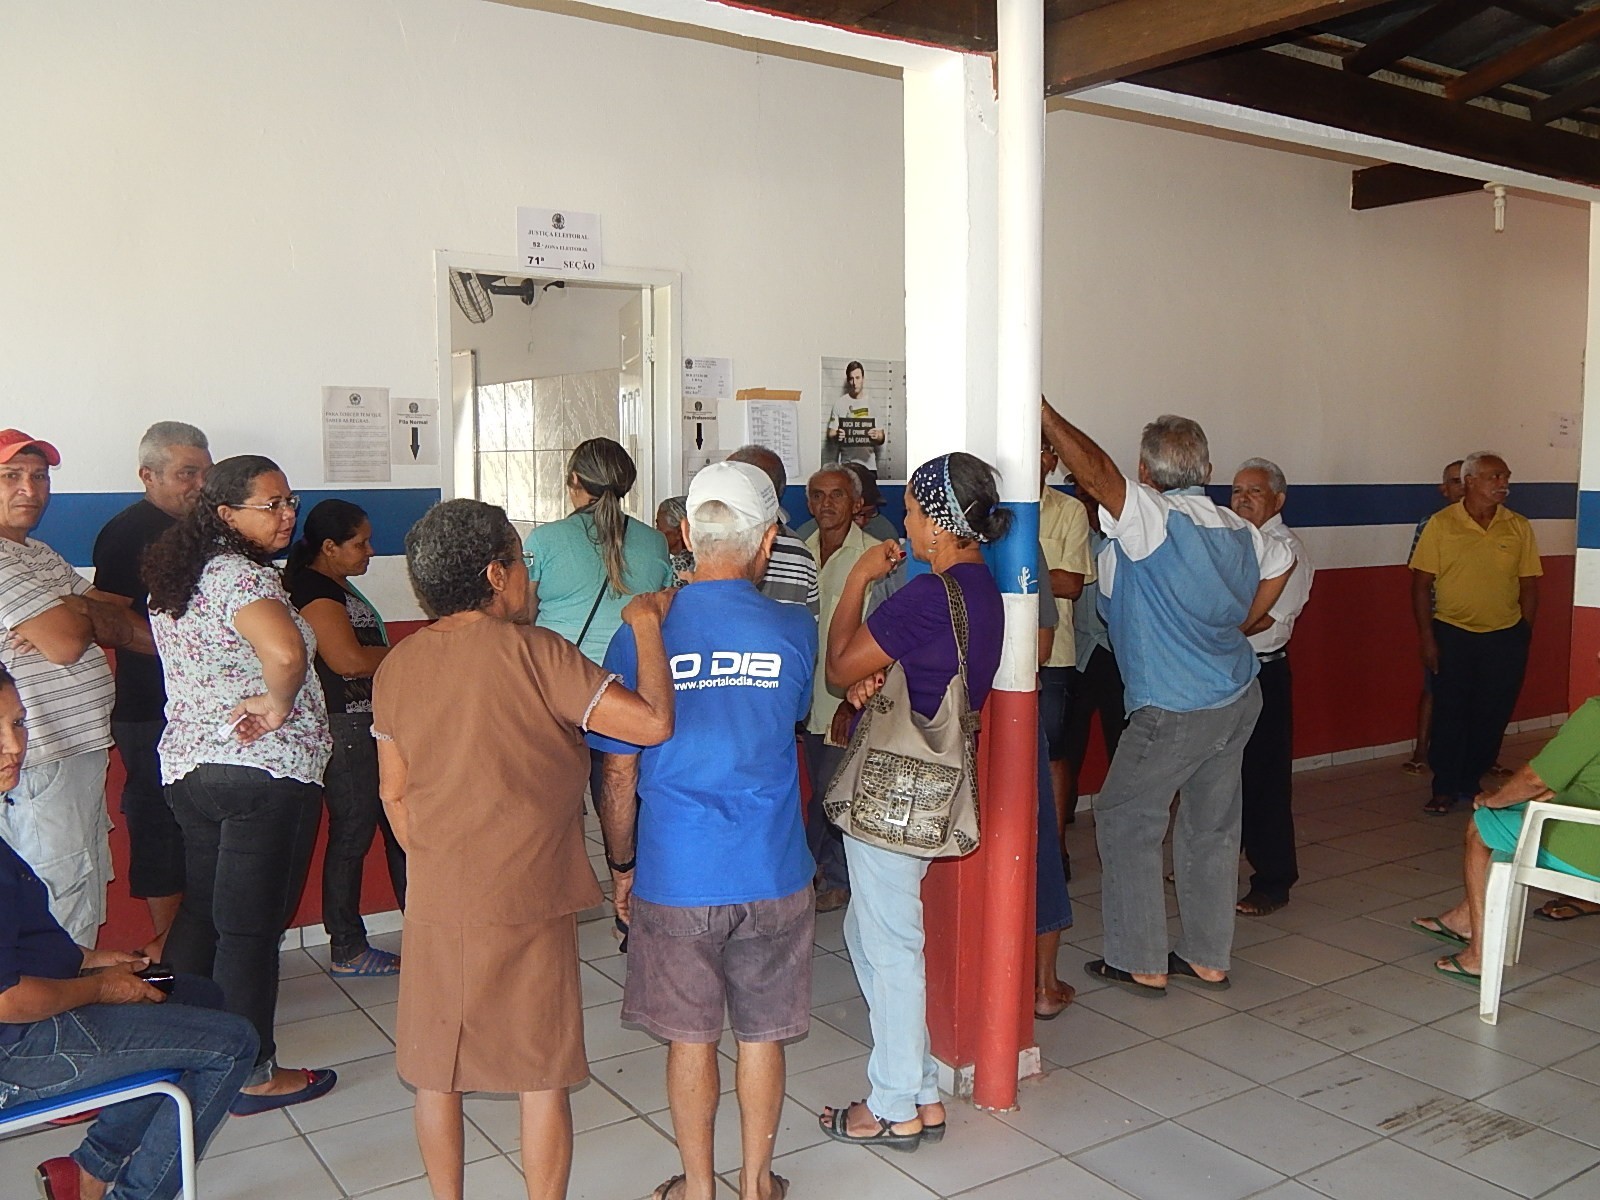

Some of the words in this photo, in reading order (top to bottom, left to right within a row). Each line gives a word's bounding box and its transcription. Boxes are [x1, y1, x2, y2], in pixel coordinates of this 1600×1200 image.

[528, 230, 554, 238] JUSTIÇA
[554, 232, 590, 240] ELEITORAL
[563, 260, 595, 270] SEÇÃO
[670, 652, 702, 680] O
[674, 676, 779, 691] www.portalodia.com
